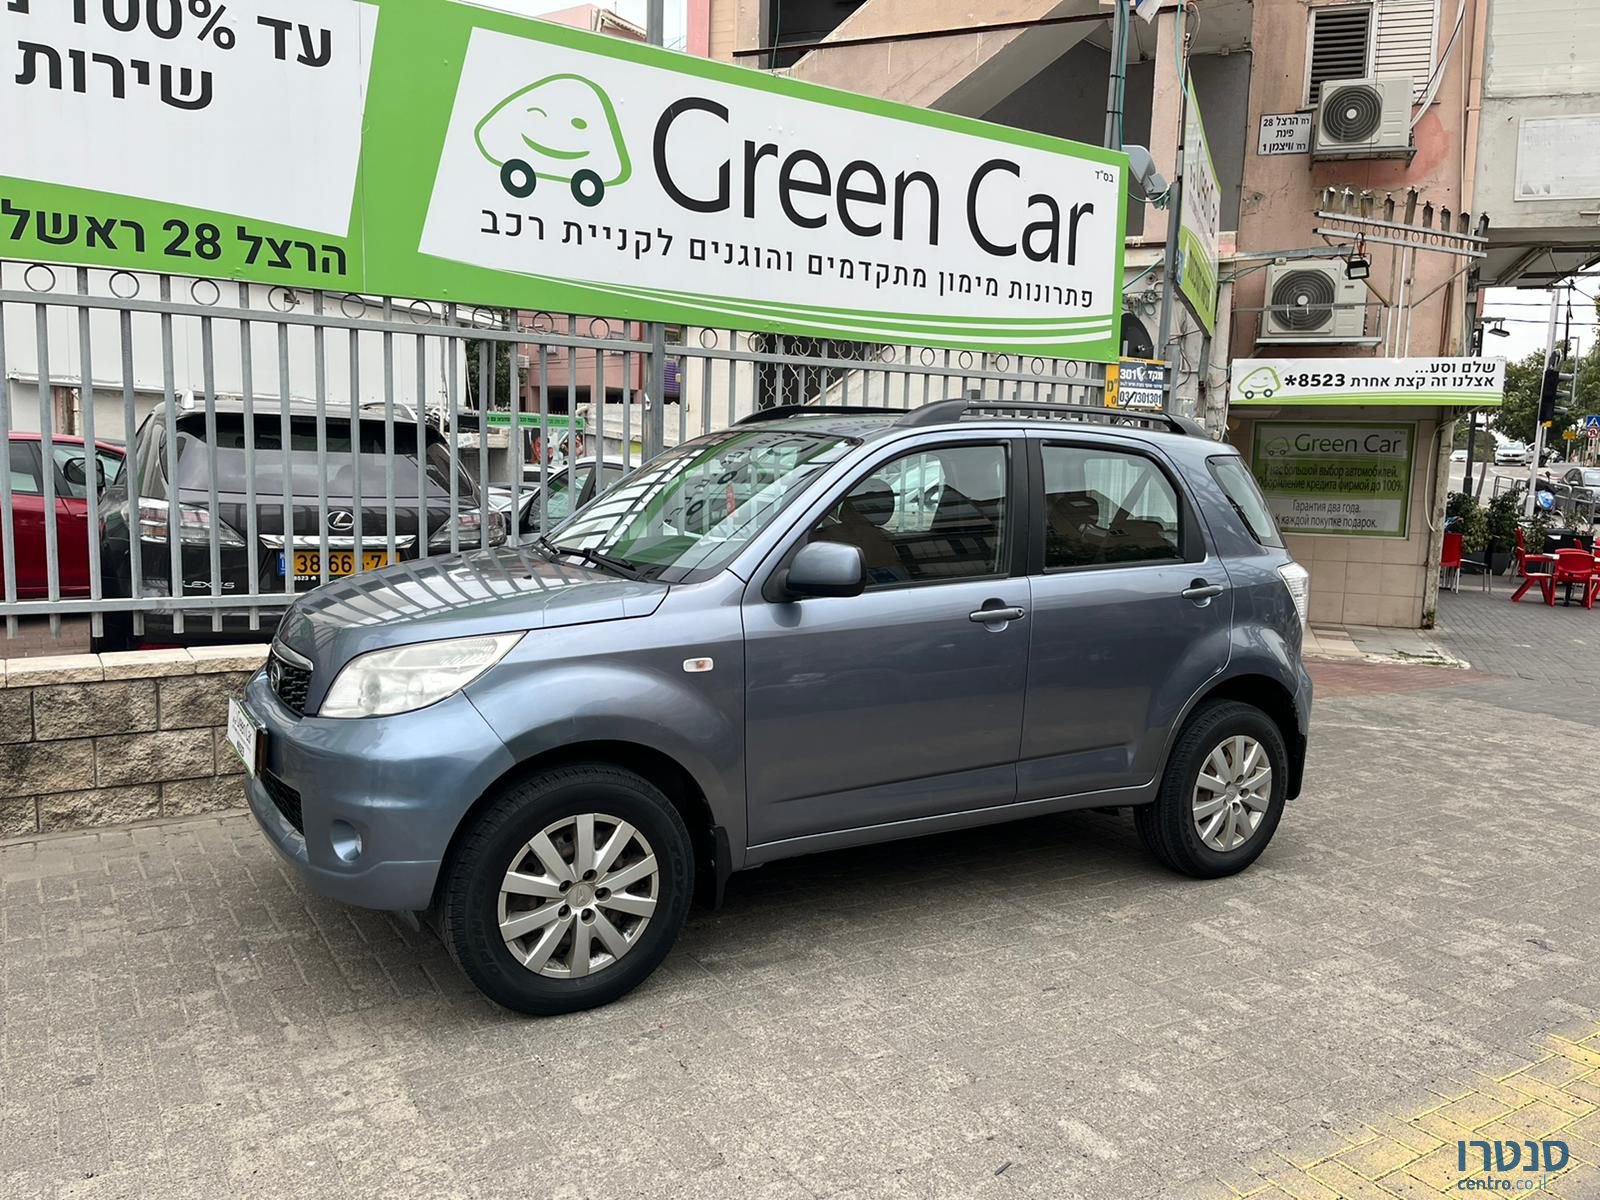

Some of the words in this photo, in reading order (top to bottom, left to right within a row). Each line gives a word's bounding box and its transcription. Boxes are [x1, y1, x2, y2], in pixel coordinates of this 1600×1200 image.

[257, 16, 332, 67] עד
[15, 40, 213, 110] שירות
[1263, 118, 1274, 127] 28
[1276, 116, 1299, 126] הרצל
[1275, 129, 1294, 138] פינת
[653, 97, 940, 246] Green
[967, 158, 1094, 266] Car
[481, 209, 544, 240] רכב
[162, 219, 221, 260] 28
[561, 220, 674, 260] לקניית
[236, 226, 347, 276] הרצל
[690, 238, 793, 272] והוגנים
[808, 254, 927, 289] מתקדמים
[938, 271, 999, 297] מימון
[1008, 280, 1094, 308] פתרונות
[1120, 368, 1137, 380] 301
[1461, 361, 1496, 374] שלם
[1349, 376, 1391, 388] אחרת
[1394, 376, 1426, 390] קצת
[1431, 376, 1448, 387] זה
[1452, 374, 1495, 387] אצלנו
[1294, 433, 1358, 453] Green
[1363, 434, 1401, 453] Car
[1292, 499, 1326, 513] Гарантия
[1327, 502, 1342, 514] два
[1310, 516, 1341, 528] покупке
[183, 580, 235, 589] LEXS
